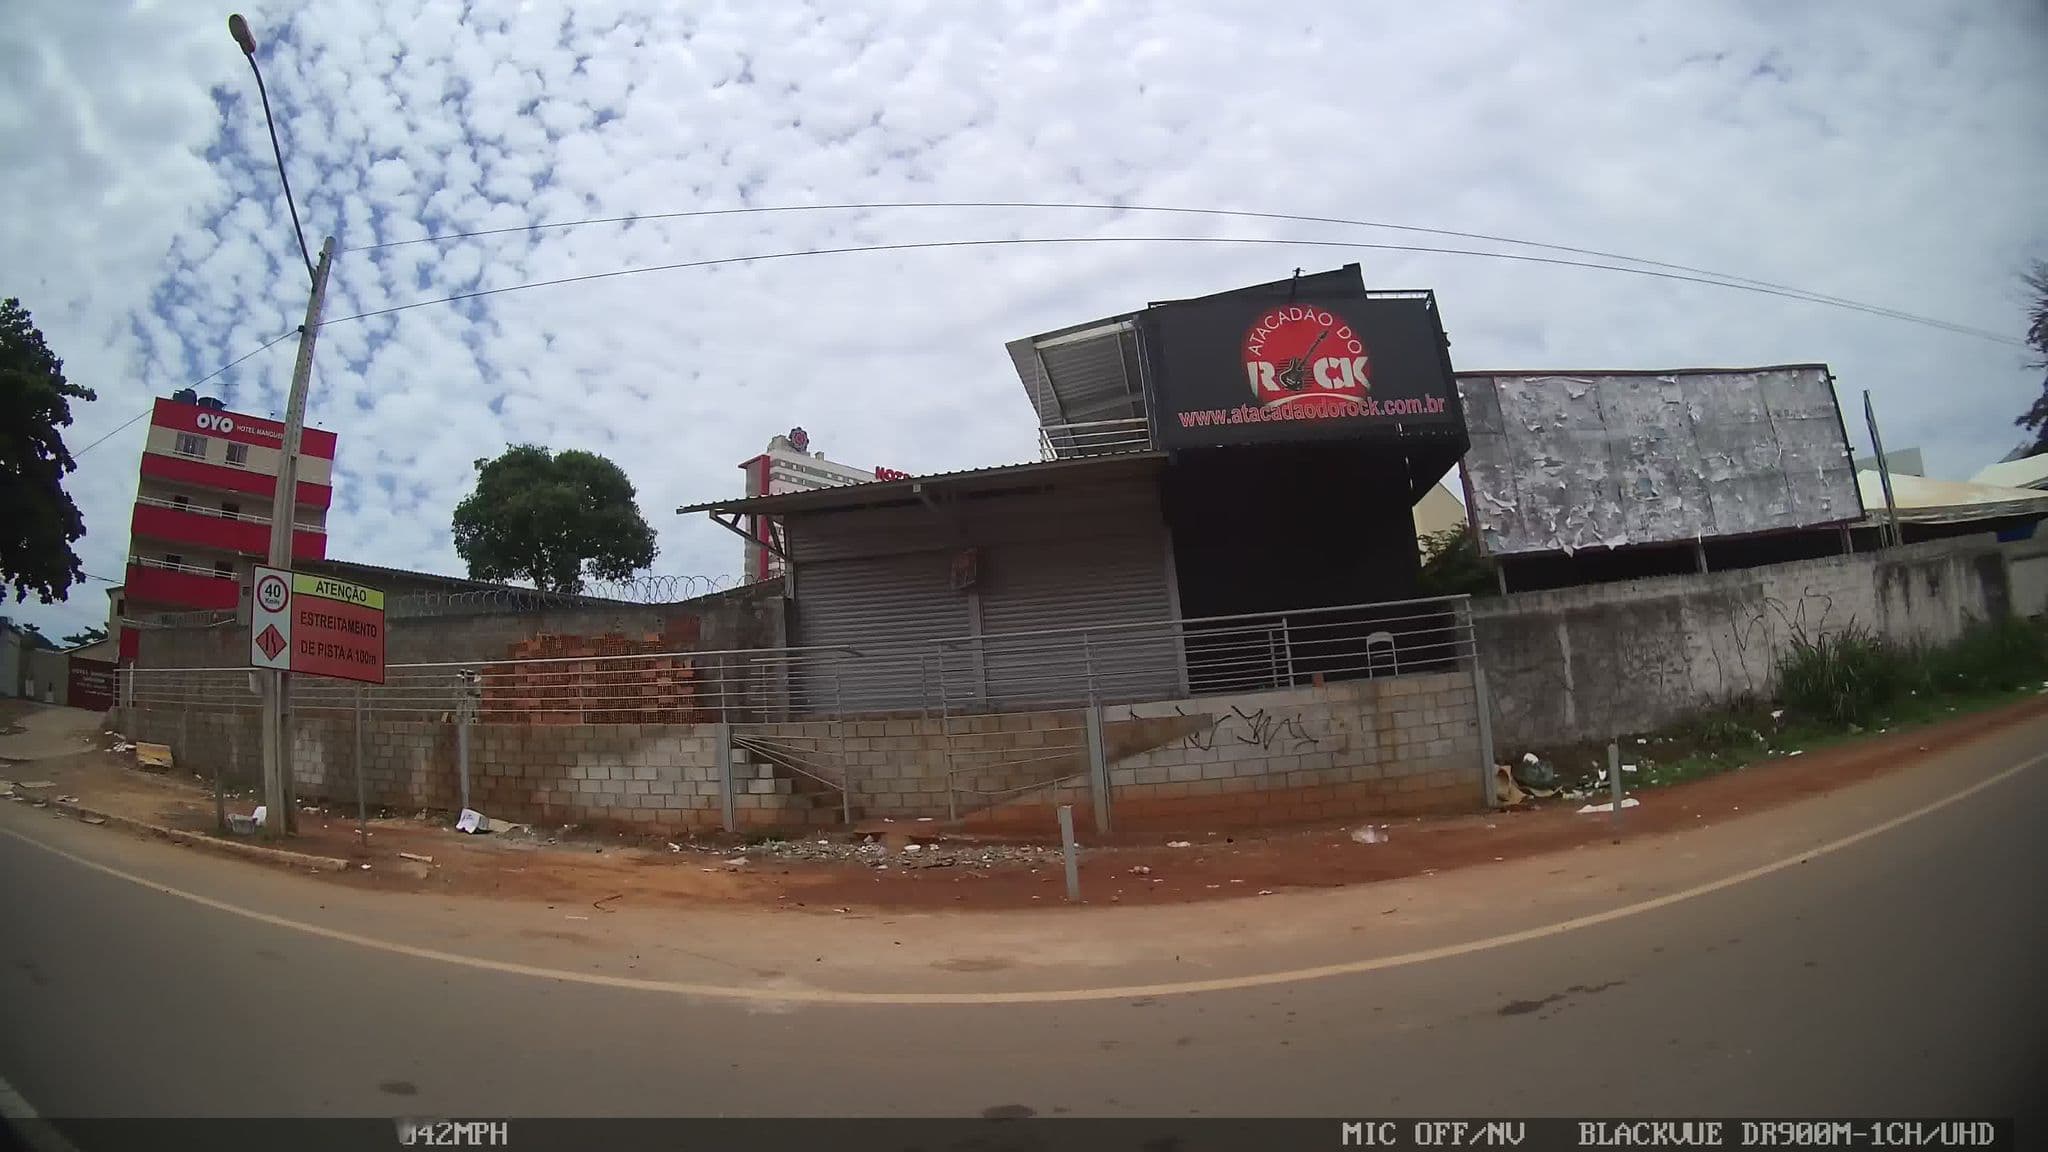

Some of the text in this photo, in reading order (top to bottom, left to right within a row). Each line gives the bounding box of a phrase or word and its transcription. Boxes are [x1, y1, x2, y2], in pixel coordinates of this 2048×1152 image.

[1336, 326, 1362, 354] DO
[1178, 394, 1446, 428] www.atacadaodorock.com.br
[196, 413, 234, 433] OYO
[236, 425, 255, 434] HOTEL
[265, 584, 281, 598] 40
[315, 581, 367, 603] ATENÇÃO
[300, 611, 377, 638] ESTREITAMENTO
[300, 640, 377, 665] DE PISTA A 100m
